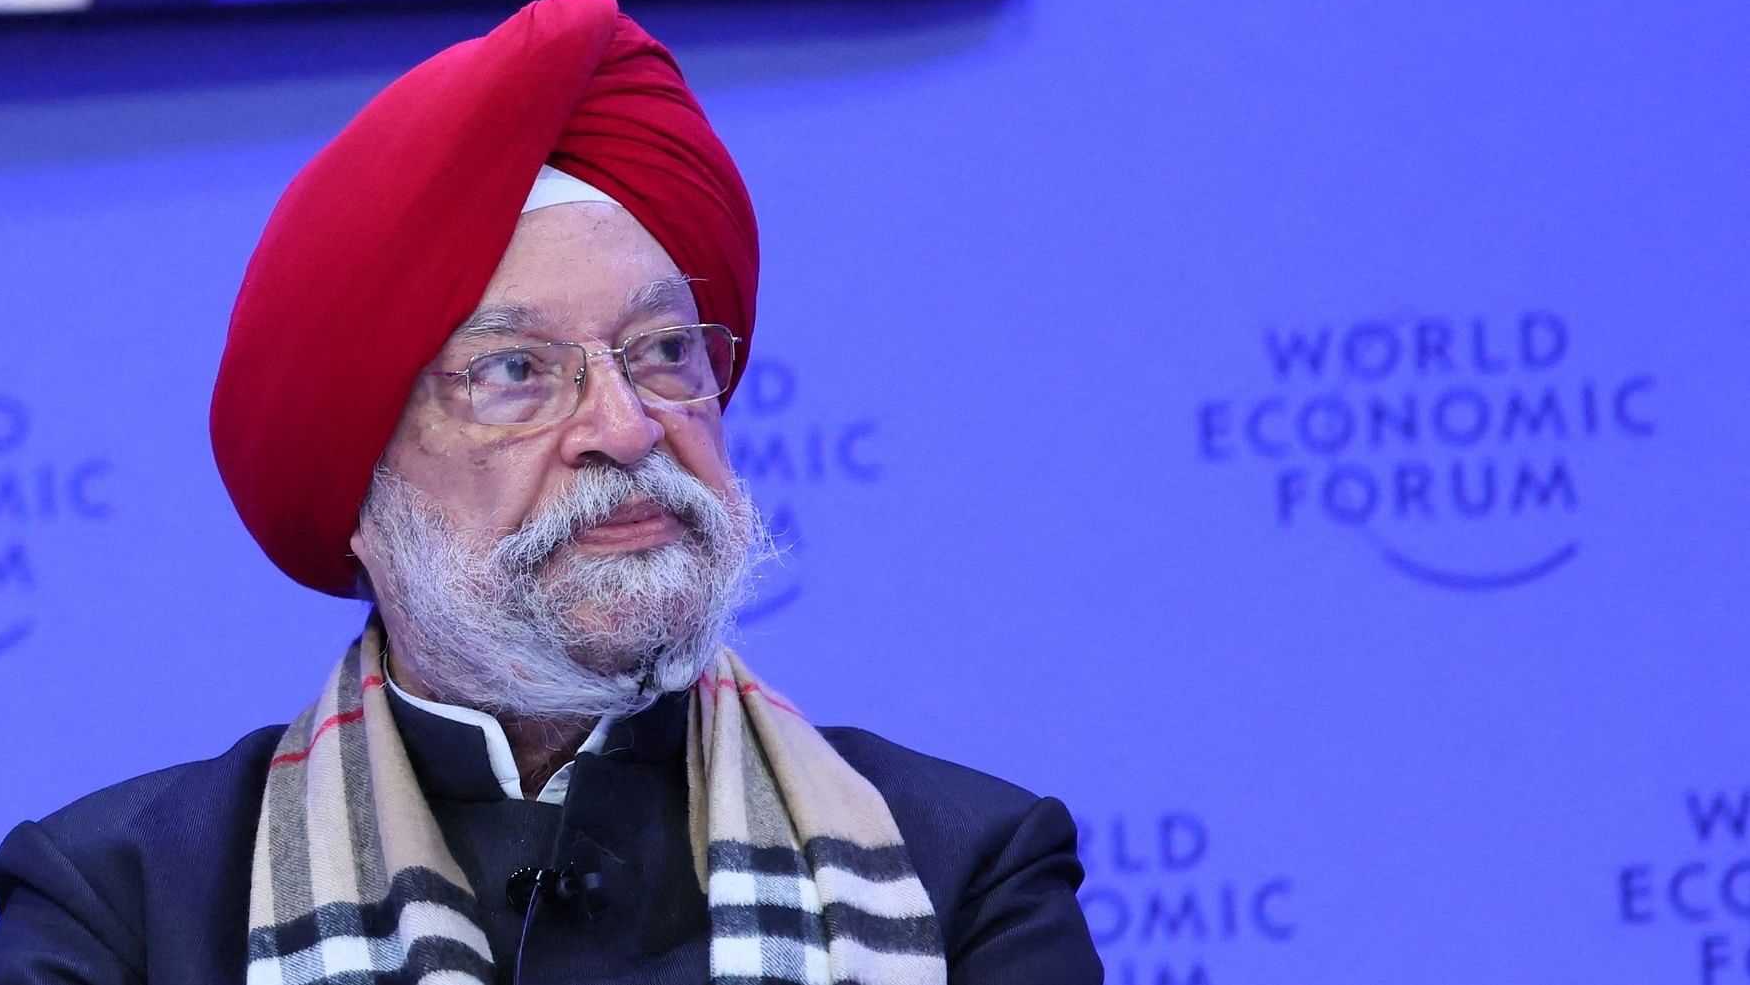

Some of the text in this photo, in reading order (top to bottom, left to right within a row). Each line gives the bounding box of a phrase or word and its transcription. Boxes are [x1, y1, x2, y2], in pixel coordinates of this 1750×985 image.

[1263, 313, 1568, 380] WORLD
[1198, 375, 1655, 462] ECONOMIC
[1276, 460, 1578, 525] FORUM
